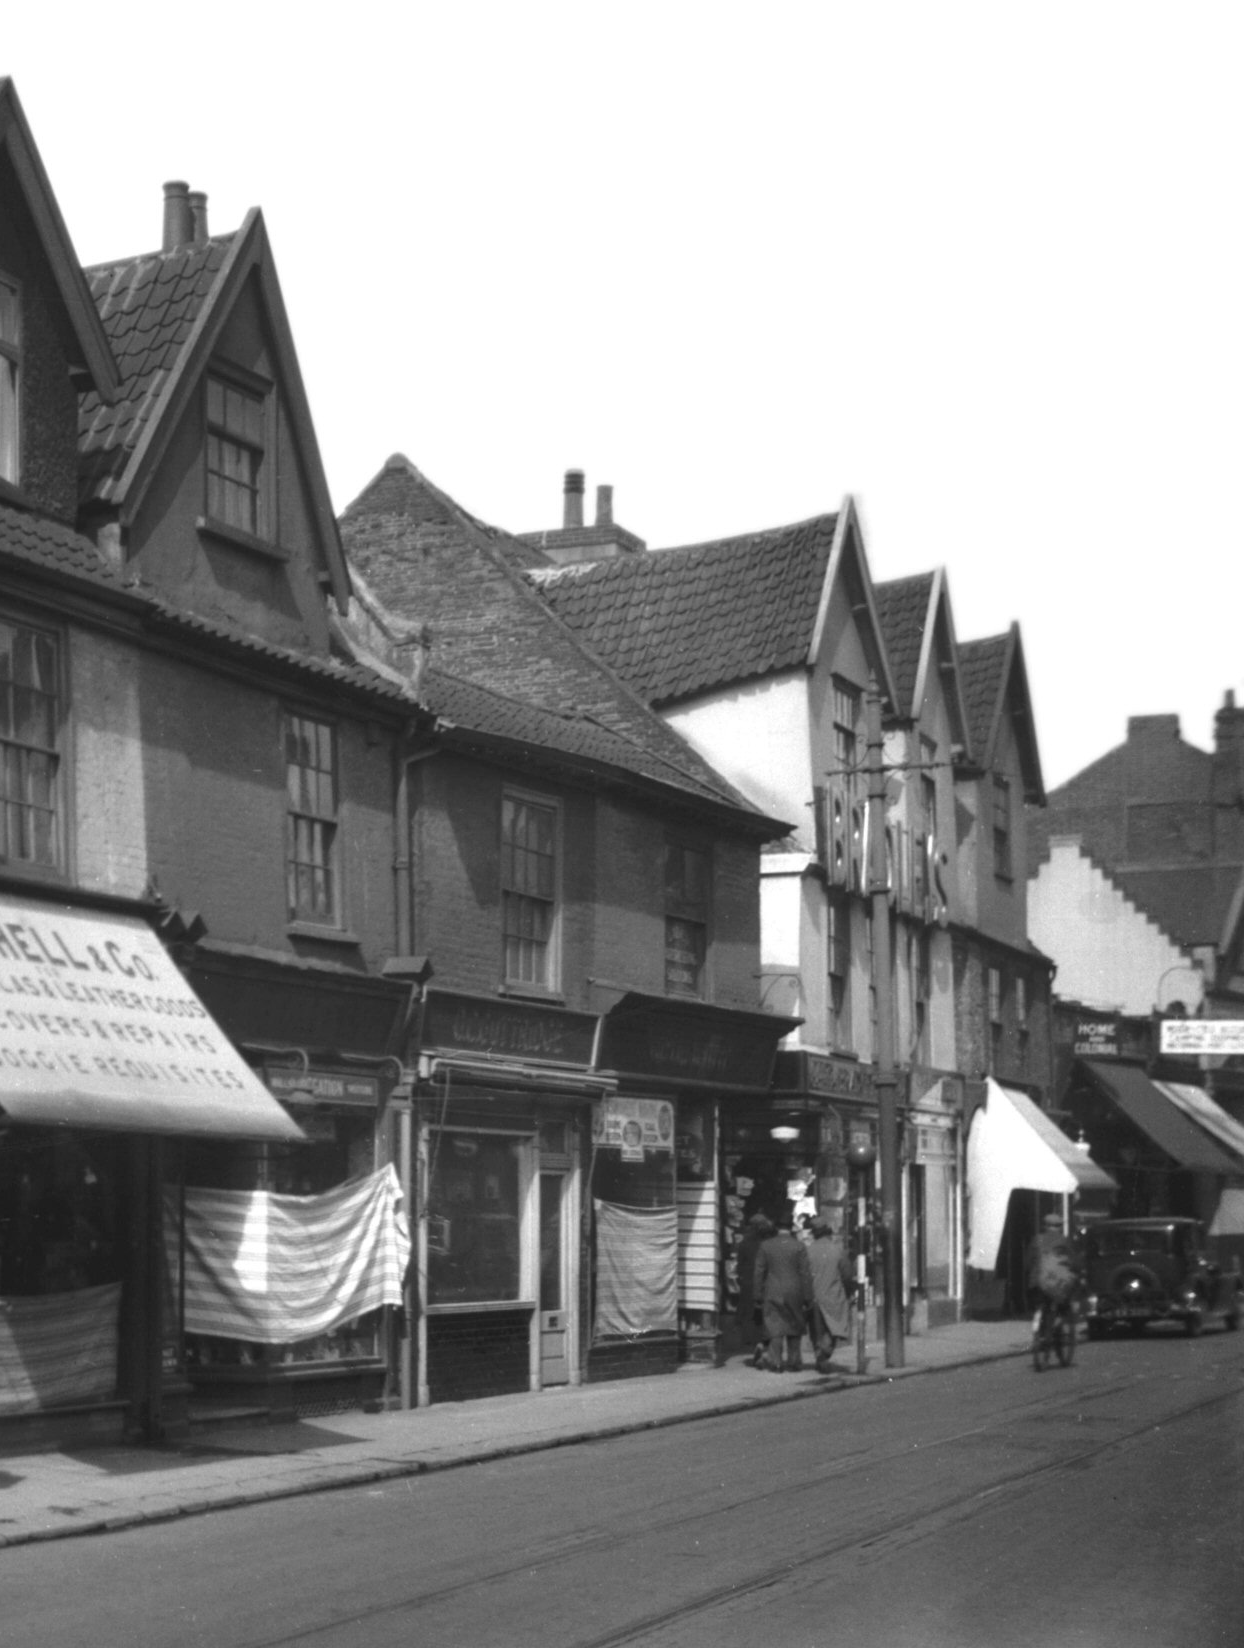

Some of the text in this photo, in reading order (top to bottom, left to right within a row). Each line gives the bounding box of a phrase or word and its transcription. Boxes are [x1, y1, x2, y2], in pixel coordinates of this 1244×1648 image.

[87, 944, 112, 975] &
[38, 978, 57, 999] &
[55, 980, 148, 1011] LEATHER
[143, 994, 207, 1019] GOODS
[92, 1018, 110, 1040] &
[109, 1021, 217, 1054] REPAIRS
[1077, 1022, 1117, 1036] HOME
[92, 1056, 246, 1090] REQUISITES
